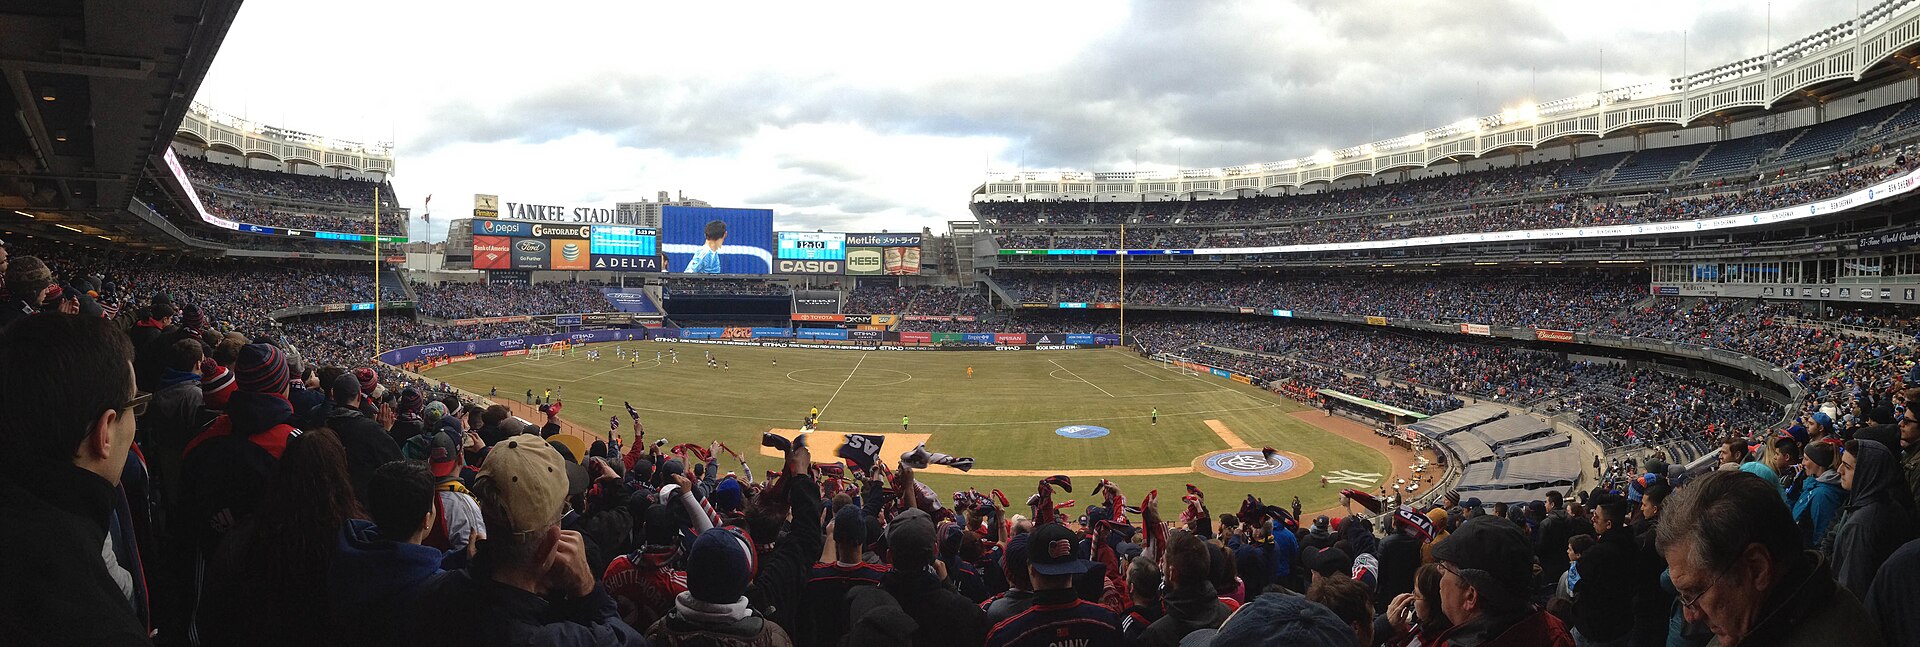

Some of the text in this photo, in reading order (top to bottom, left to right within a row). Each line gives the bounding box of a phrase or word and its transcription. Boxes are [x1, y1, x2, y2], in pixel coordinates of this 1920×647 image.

[506, 202, 640, 225] YANKEE STADIUM
[496, 223, 520, 233] pepsi
[543, 225, 579, 236] GATORADE
[847, 235, 920, 245] MetLife メットライフ
[1881, 233, 1898, 244] World
[520, 241, 540, 251] Ford
[611, 258, 656, 269] DELTA
[849, 256, 879, 265] HESS
[780, 260, 838, 273] CASIO
[1537, 330, 1573, 340] Budweiser
[421, 346, 445, 354] ETIHAD
